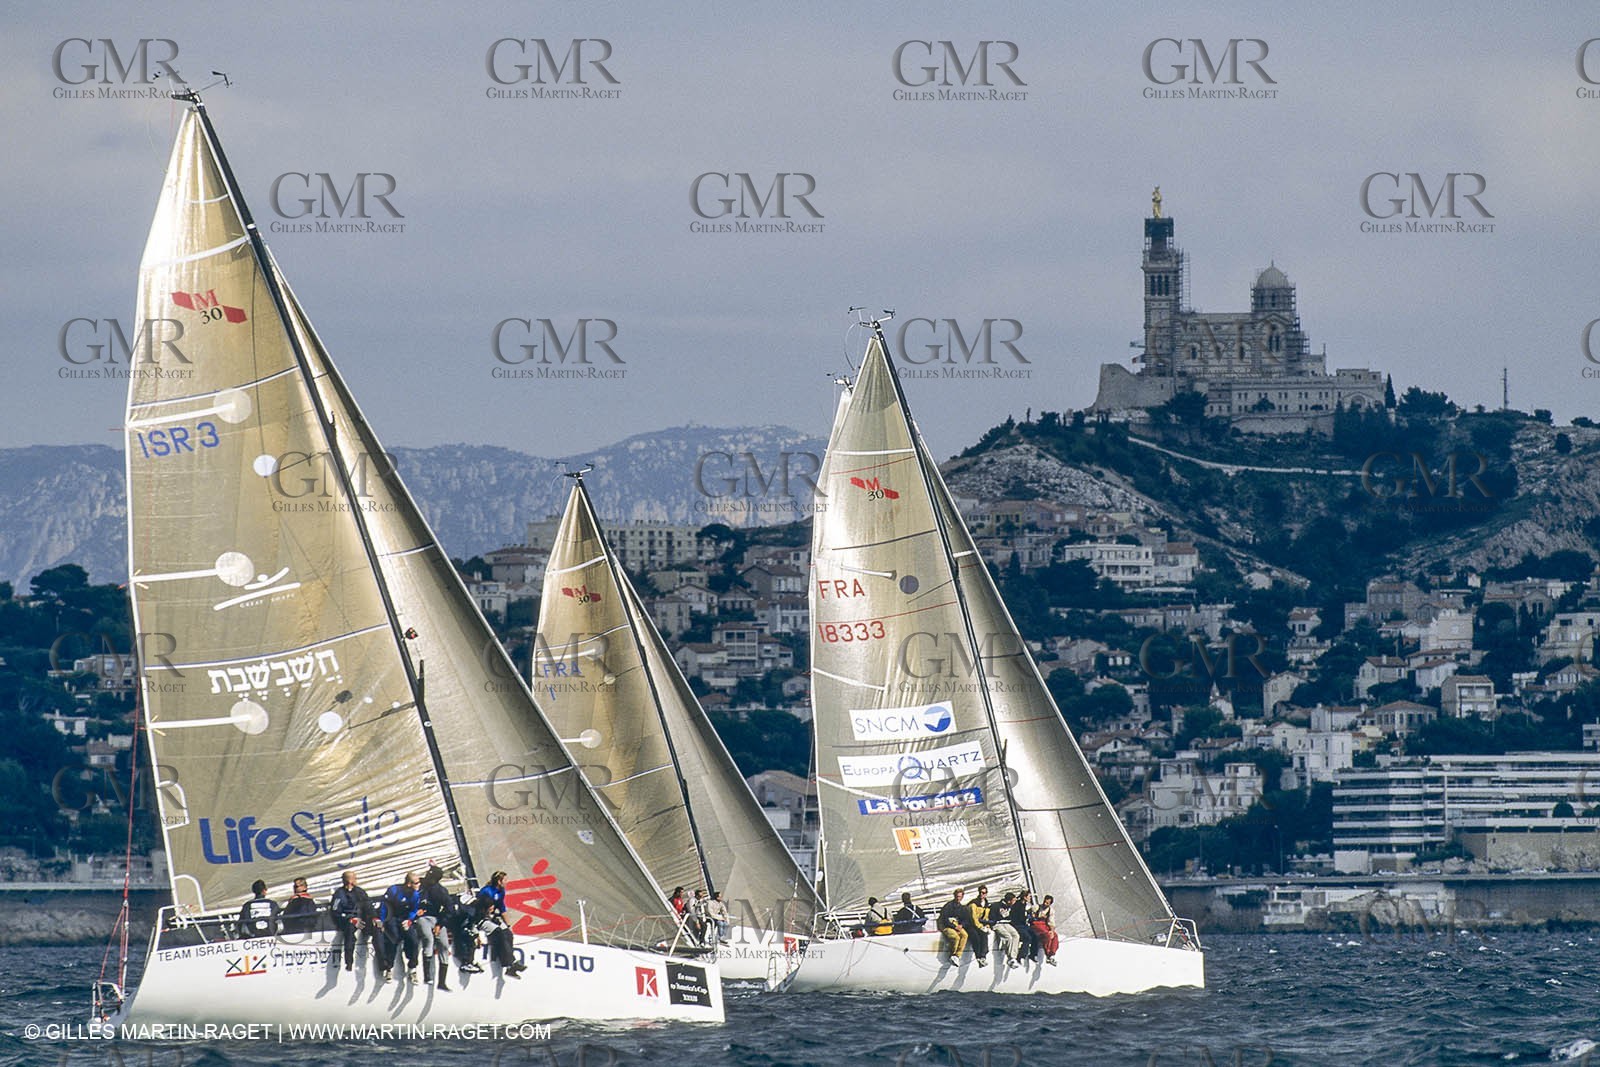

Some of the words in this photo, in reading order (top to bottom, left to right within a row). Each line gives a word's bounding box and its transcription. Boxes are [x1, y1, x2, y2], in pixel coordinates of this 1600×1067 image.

[200, 307, 222, 325] 30
[137, 426, 194, 459] ISR
[197, 421, 220, 448] 3
[867, 489, 884, 501] 30
[818, 578, 865, 599] FRA
[817, 620, 885, 643] 18333
[543, 661, 582, 679] FRA
[854, 714, 920, 734] SNCM
[199, 795, 400, 868] LifeStyle
[926, 833, 970, 850] PACA
[157, 951, 192, 963] TEAM
[195, 943, 239, 958] ISRAEL
[242, 939, 278, 951] CREW
[641, 973, 658, 999] K
